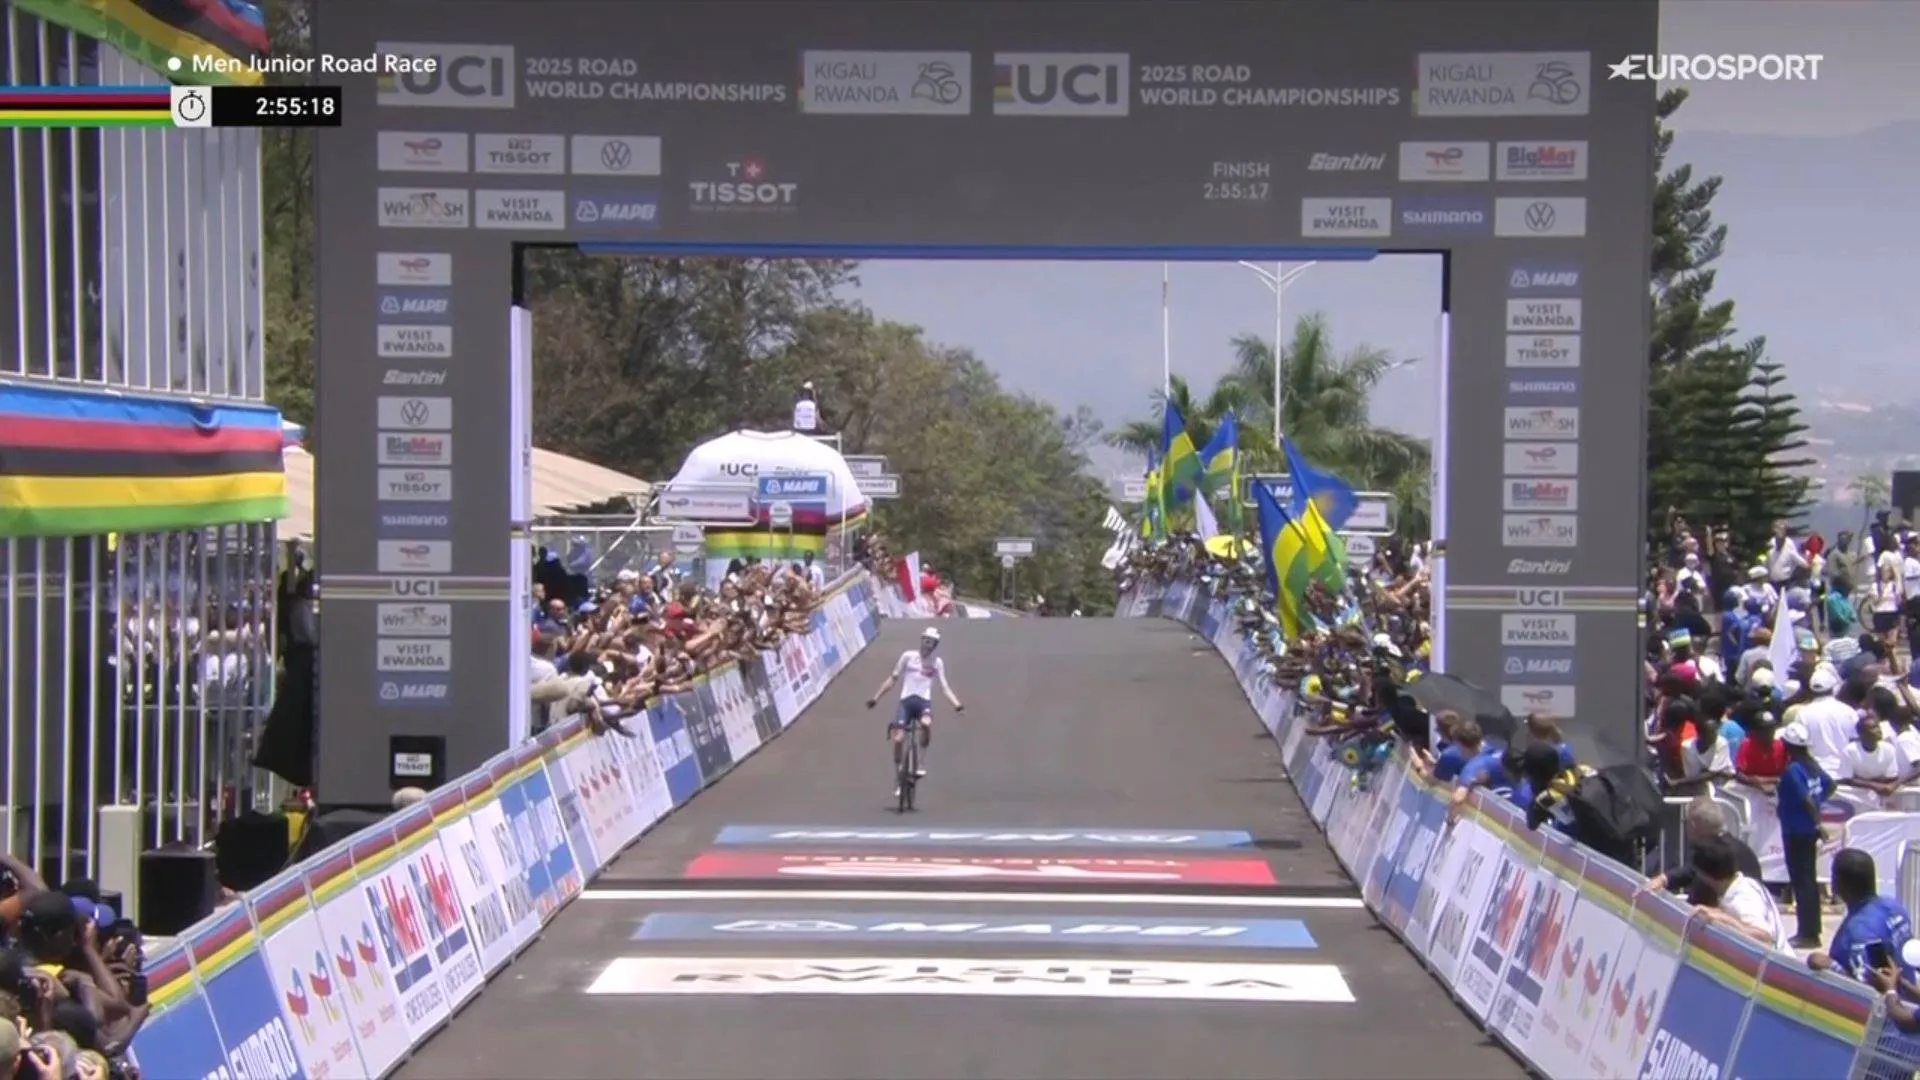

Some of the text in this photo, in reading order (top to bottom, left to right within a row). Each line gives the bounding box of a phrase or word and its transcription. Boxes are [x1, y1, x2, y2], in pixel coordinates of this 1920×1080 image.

[526, 58, 637, 76] 2025 ROAD
[814, 62, 877, 80] KIGALI
[1140, 65, 1251, 82] 2025 ROAD
[1428, 63, 1493, 82] KIGALI
[401, 55, 504, 96] UCI
[526, 81, 787, 102] WORLD CHAMPIONSHIPS
[1016, 64, 1118, 105] UCI
[814, 85, 899, 104] RWANDA
[1140, 88, 1400, 106] WORLD CHAMPIONSHIPS
[1428, 88, 1516, 106] RWANDA
[488, 151, 551, 164] TISSOT
[1308, 152, 1387, 171] Santini
[1507, 146, 1576, 166] BigMat
[1212, 160, 1270, 178] FINISH
[689, 182, 798, 203] TISSOT
[1203, 182, 1270, 200] 2:55:17
[501, 198, 540, 210] VISIT
[487, 211, 553, 222] RWANDA
[601, 203, 657, 221] MAPEI
[1327, 206, 1366, 218] VISIT
[1403, 210, 1483, 224] SHIMANO
[1312, 218, 1379, 229] RWANDA
[1531, 272, 1579, 286] MAPEI
[402, 299, 448, 313] MAPEI
[1526, 304, 1562, 314] VISIT
[1512, 315, 1575, 326] RWANDA
[397, 330, 433, 341] VISIT
[383, 342, 445, 352] RWANDA
[1517, 350, 1570, 360] TISSOT
[389, 483, 441, 493] TISSOT
[782, 480, 819, 492] MAPEI
[395, 580, 435, 596] UCI
[1518, 590, 1560, 606] UCI
[1521, 619, 1557, 629] VISIT
[1507, 631, 1569, 641] RWANDA
[396, 644, 432, 655] VISIT
[383, 656, 444, 666] RWANDA
[1526, 659, 1572, 674] MAPEI
[402, 684, 448, 698] MAPEI
[868, 922, 1250, 936] MAPEI
[806, 964, 1152, 976] VISIT
[671, 973, 1289, 989] RWANDA
